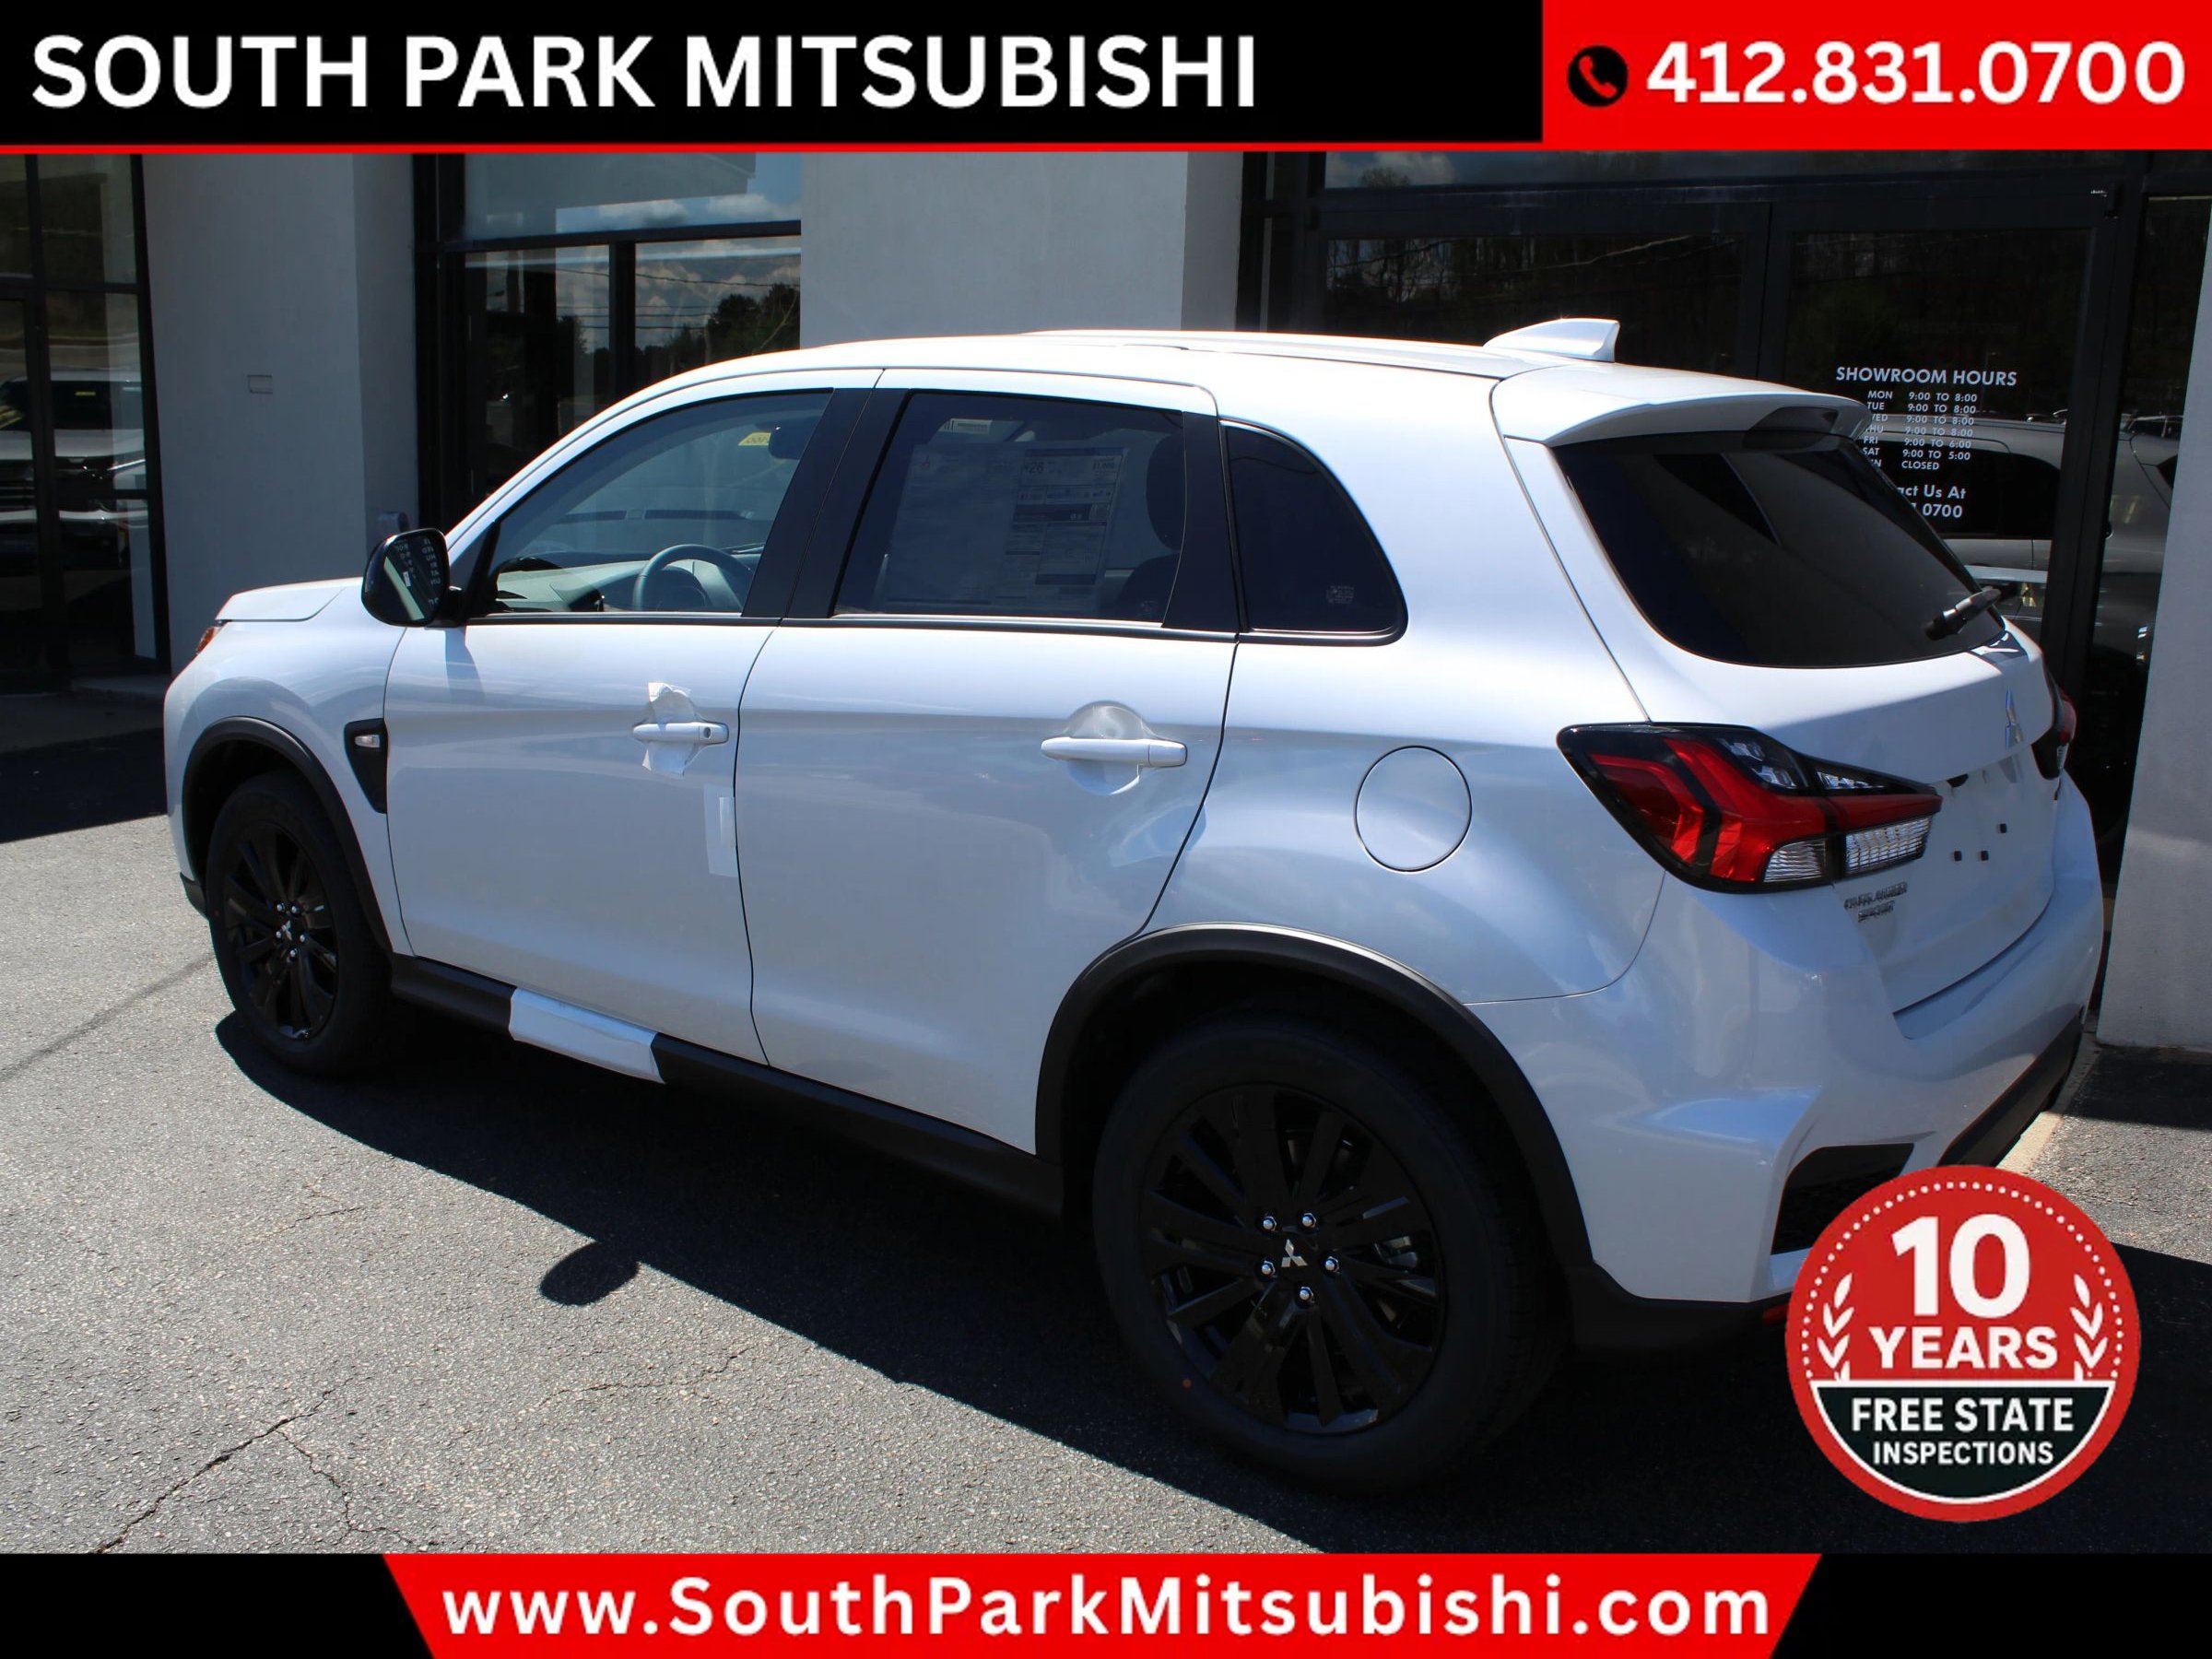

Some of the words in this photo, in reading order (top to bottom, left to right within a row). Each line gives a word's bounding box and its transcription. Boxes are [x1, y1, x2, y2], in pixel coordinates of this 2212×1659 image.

[1836, 366, 1947, 384] SHOWROOM
[1952, 370, 2018, 386] HOURS
[1867, 390, 1893, 400] MON
[1909, 392, 1931, 401] 9:00
[1936, 393, 1949, 402] TO
[1955, 394, 1978, 403] 8:00
[1866, 401, 1885, 411] TUE
[1907, 403, 1929, 412] 9:00
[1934, 404, 1947, 413] TO
[1953, 405, 1977, 414] 8:00
[1872, 413, 1888, 422] ED
[1906, 414, 1927, 424] 9:00
[1932, 415, 1947, 424] TO
[1952, 416, 1974, 426] 8:00
[1865, 424, 1884, 433] HU
[1904, 426, 1926, 436] 9:00
[1932, 427, 1946, 436] TO
[1950, 428, 1973, 438] 8:00
[1863, 435, 1878, 445] FRI
[1903, 438, 1925, 447] 9:00
[1931, 439, 1944, 448] TO
[1948, 440, 1971, 449] 6:00
[1863, 446, 1879, 456] SAT
[1902, 448, 1924, 458] 9:00
[1928, 450, 1942, 459] TO
[1947, 451, 1971, 461] 5:00
[1901, 460, 1939, 470] CLOSED
[1924, 484, 1942, 499] Us
[1947, 486, 1967, 500] At
[1923, 502, 1963, 518] 0700
